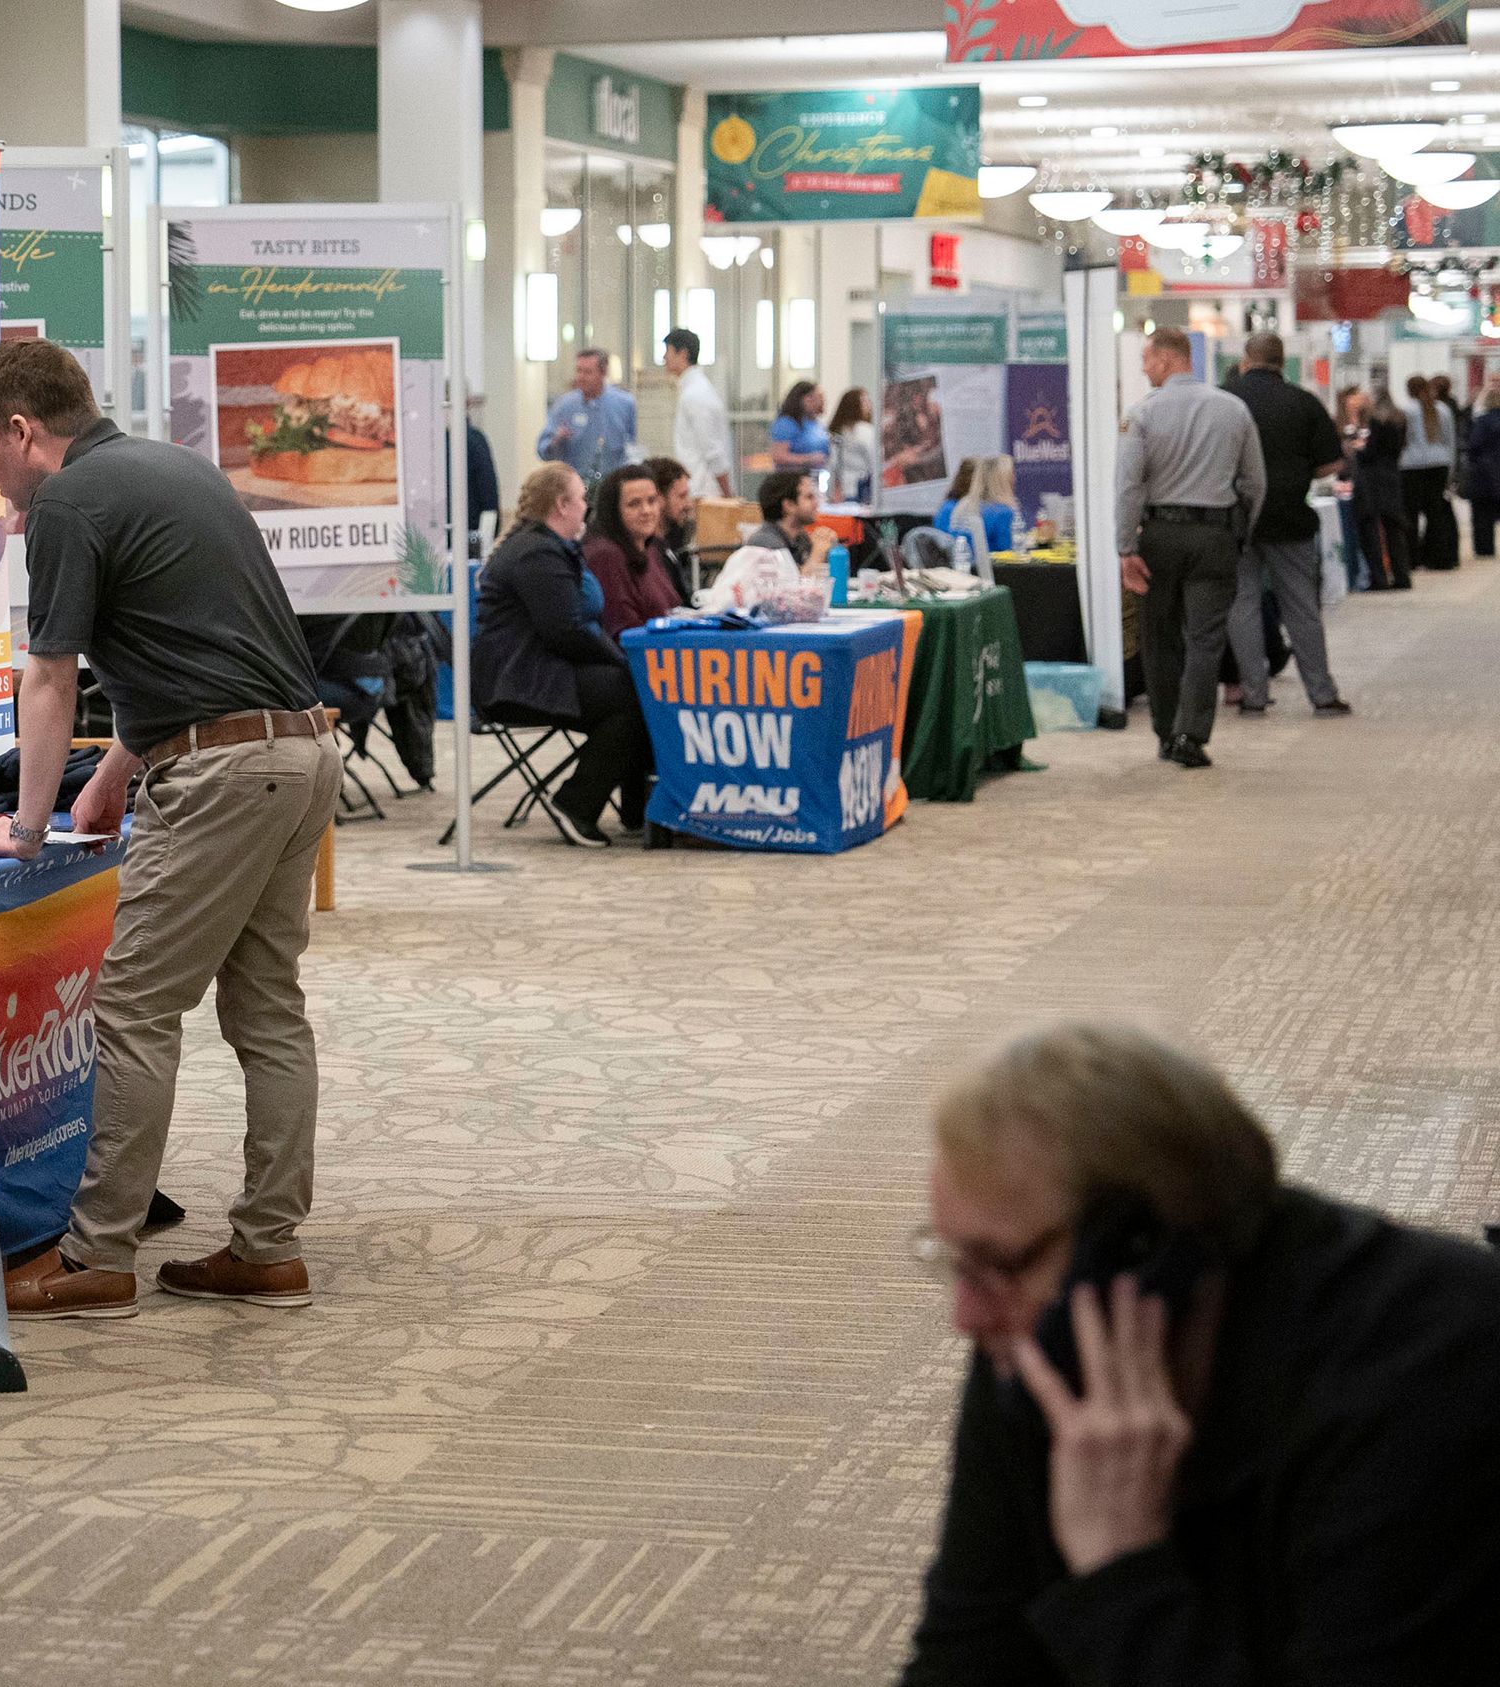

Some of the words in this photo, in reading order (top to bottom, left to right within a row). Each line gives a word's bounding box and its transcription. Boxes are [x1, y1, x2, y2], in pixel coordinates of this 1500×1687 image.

[251, 240, 306, 255] TASTY
[311, 240, 361, 255] BITES
[289, 525, 344, 549] RIDGE
[349, 522, 388, 546] DELI
[645, 648, 822, 709] HIRING
[677, 709, 793, 769] NOW
[688, 782, 800, 816] MAU
